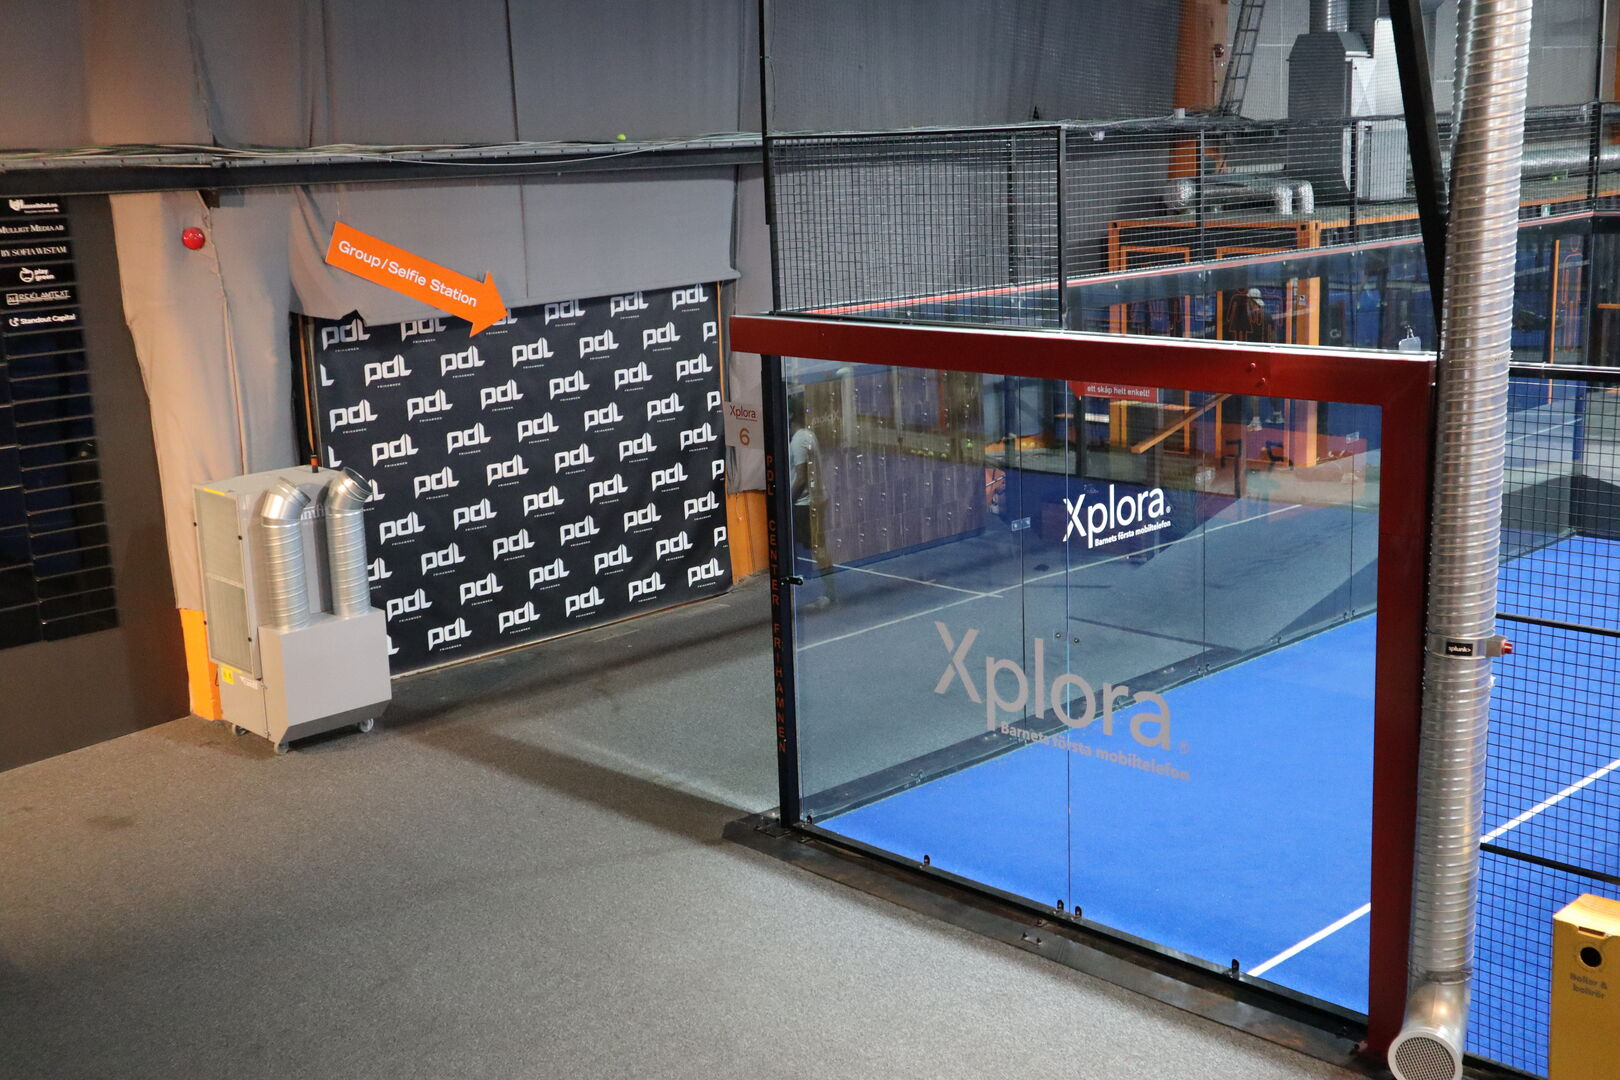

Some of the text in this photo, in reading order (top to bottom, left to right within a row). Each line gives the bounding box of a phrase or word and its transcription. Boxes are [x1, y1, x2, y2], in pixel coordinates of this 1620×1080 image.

[338, 240, 477, 308] Group/Selfie Station
[730, 404, 757, 420] Xplora
[740, 427, 750, 446] 6
[1062, 483, 1165, 549] Xplora
[1094, 535, 1118, 547] Barnets
[766, 455, 786, 753] PDL CENTER FRIHAMNEN
[934, 620, 1171, 751] Xplora
[1001, 722, 1050, 745] Barnets
